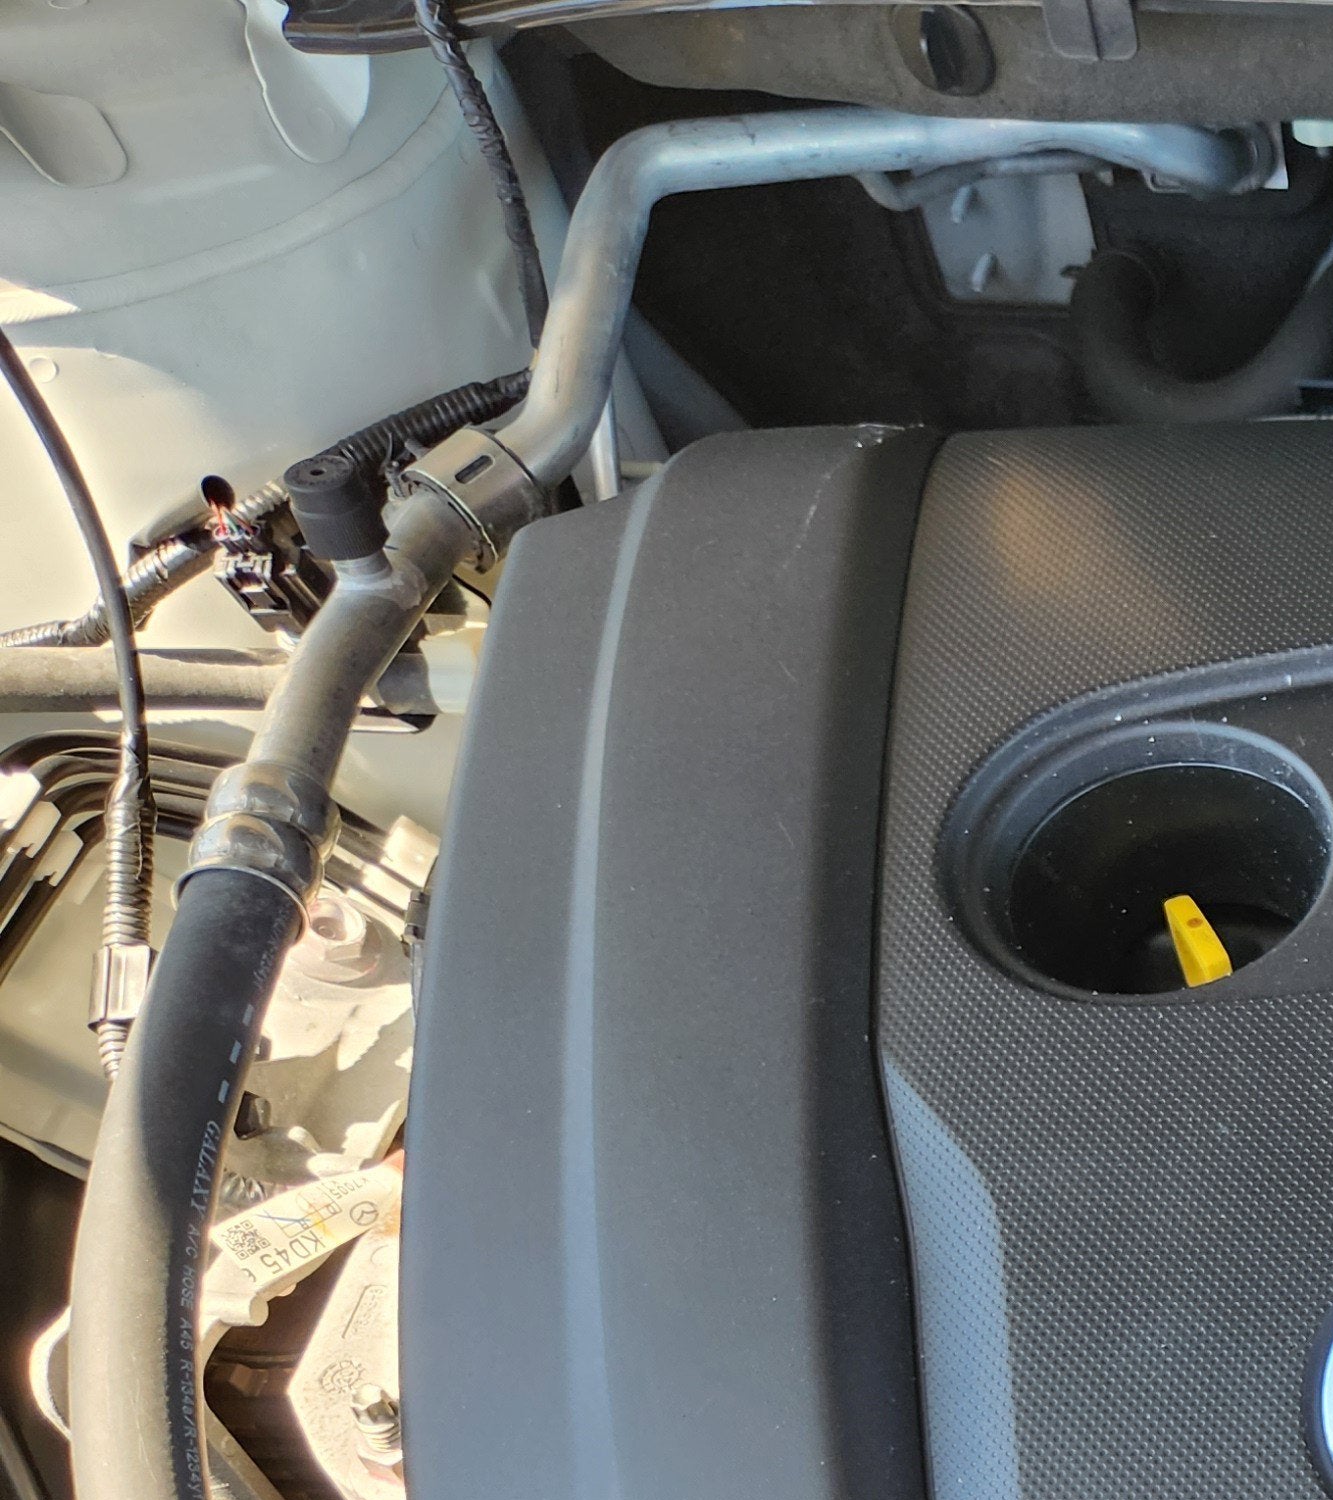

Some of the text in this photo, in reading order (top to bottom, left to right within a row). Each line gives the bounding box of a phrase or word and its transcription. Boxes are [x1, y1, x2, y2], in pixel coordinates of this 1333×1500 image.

[190, 1120, 221, 1220] GALAXY
[185, 1223, 199, 1259] A/C
[259, 1229, 327, 1275] KD45
[180, 1264, 197, 1311] HOSE
[179, 1317, 193, 1350] A45
